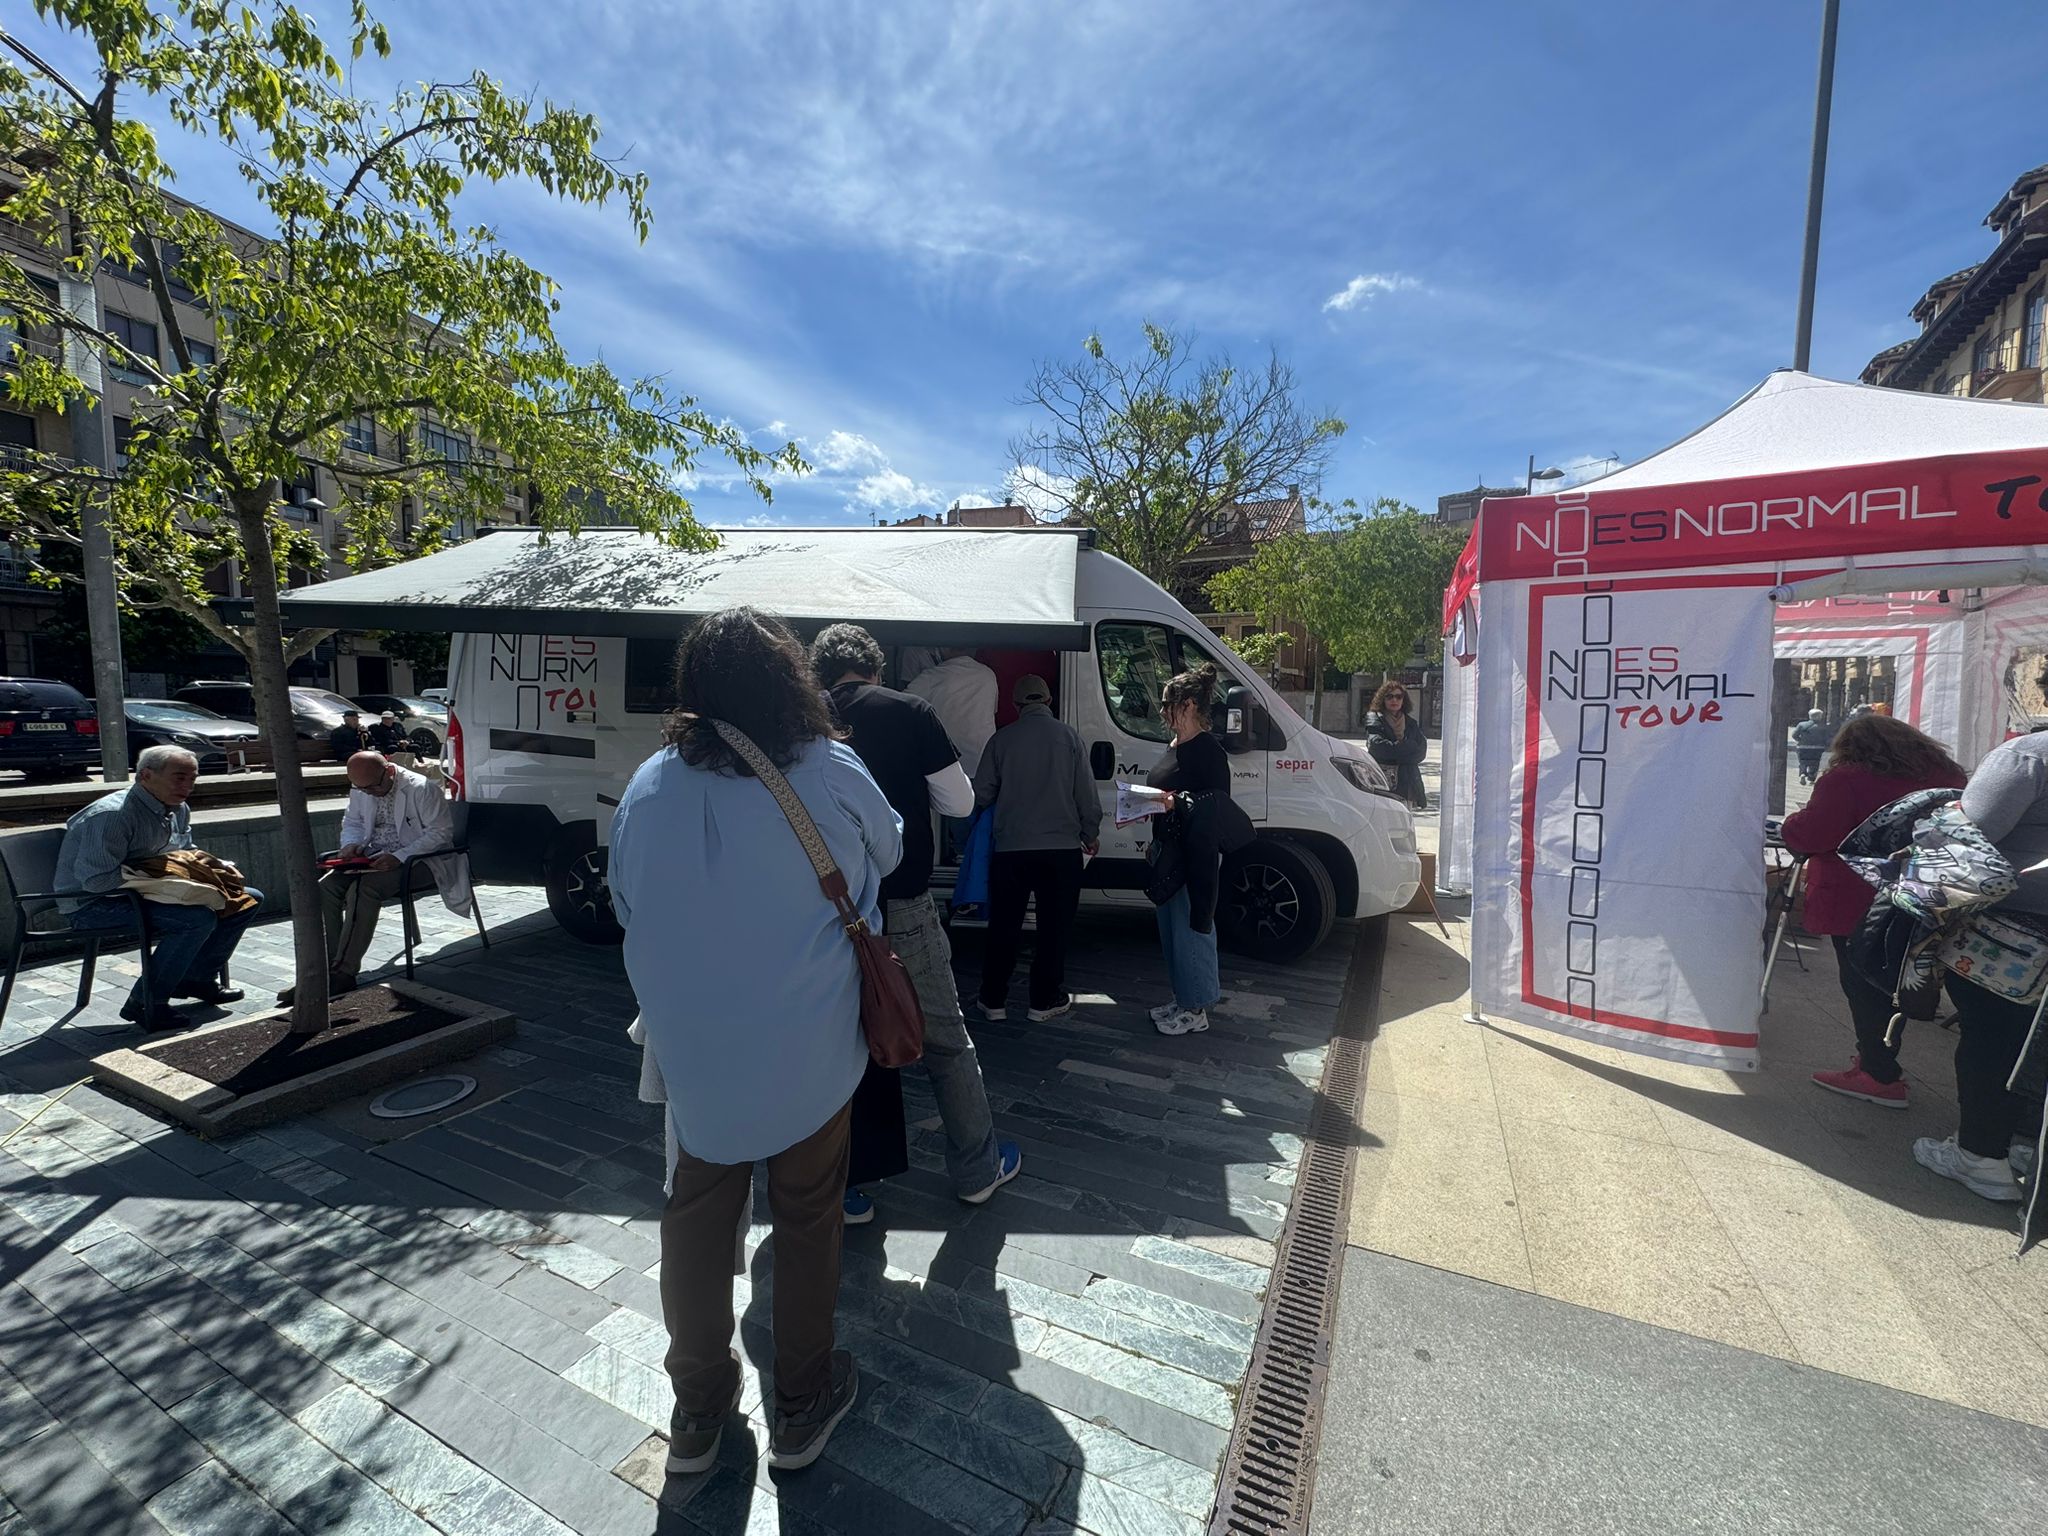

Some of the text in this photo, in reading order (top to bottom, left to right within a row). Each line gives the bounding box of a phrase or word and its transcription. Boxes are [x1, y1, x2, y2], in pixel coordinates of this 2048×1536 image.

[1547, 673, 1755, 700] NORMAL
[1615, 700, 1723, 729] TOUR
[1275, 759, 1315, 773] separ
